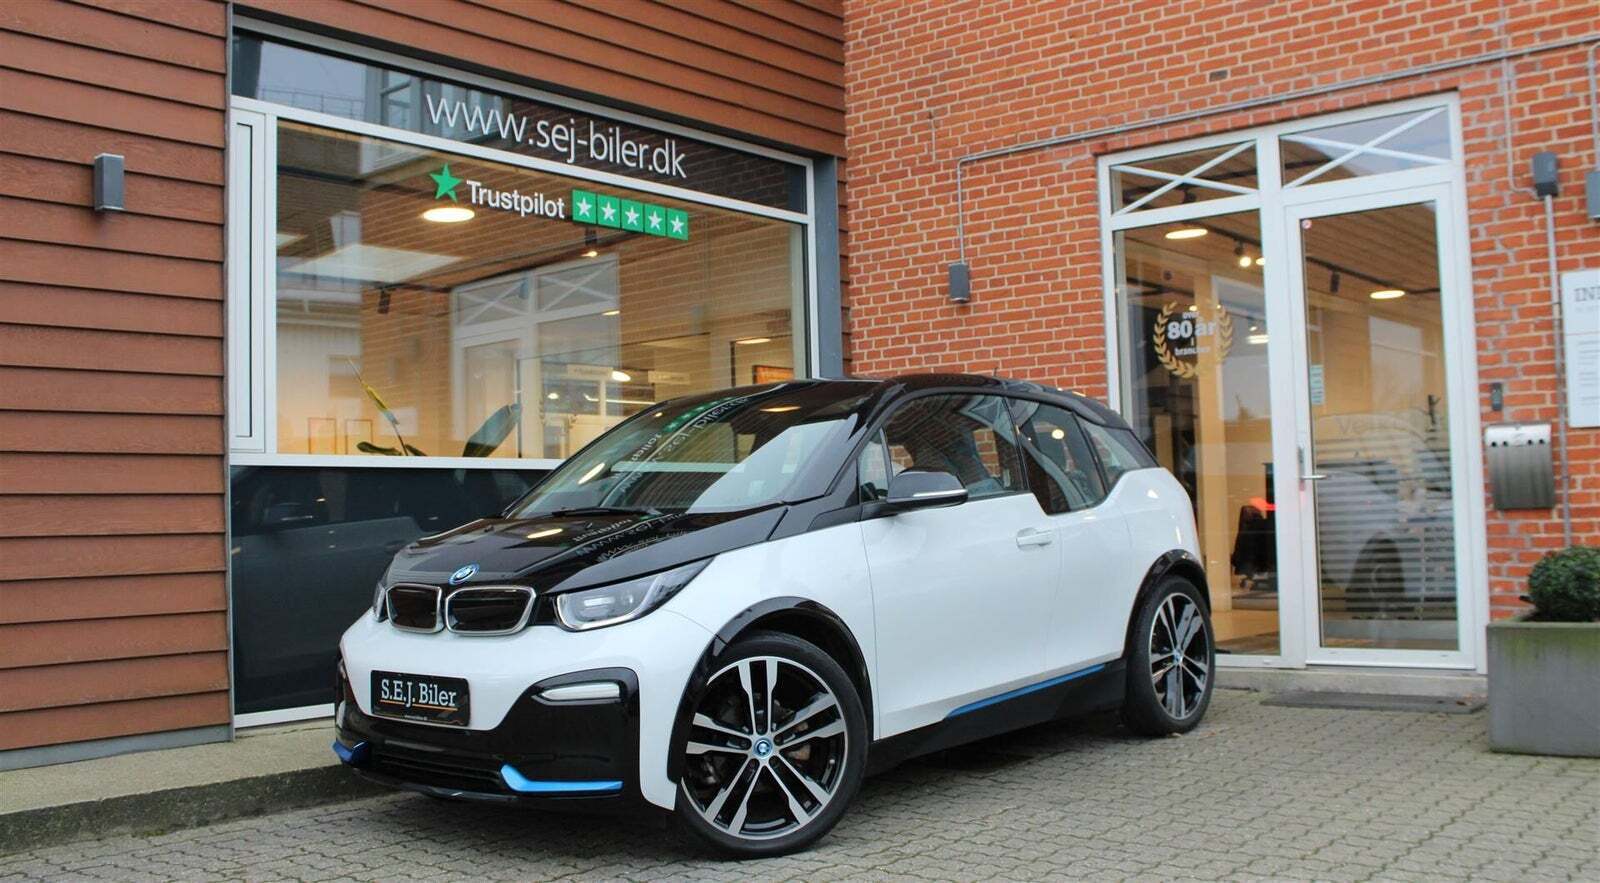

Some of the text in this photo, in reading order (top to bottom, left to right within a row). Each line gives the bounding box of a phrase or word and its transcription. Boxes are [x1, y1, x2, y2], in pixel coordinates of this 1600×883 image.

[426, 93, 687, 178] www.sej-biler.dk
[466, 180, 565, 219] Trustpilot
[1167, 321, 1193, 340] 80
[381, 679, 457, 707] S.E.J. Biler
